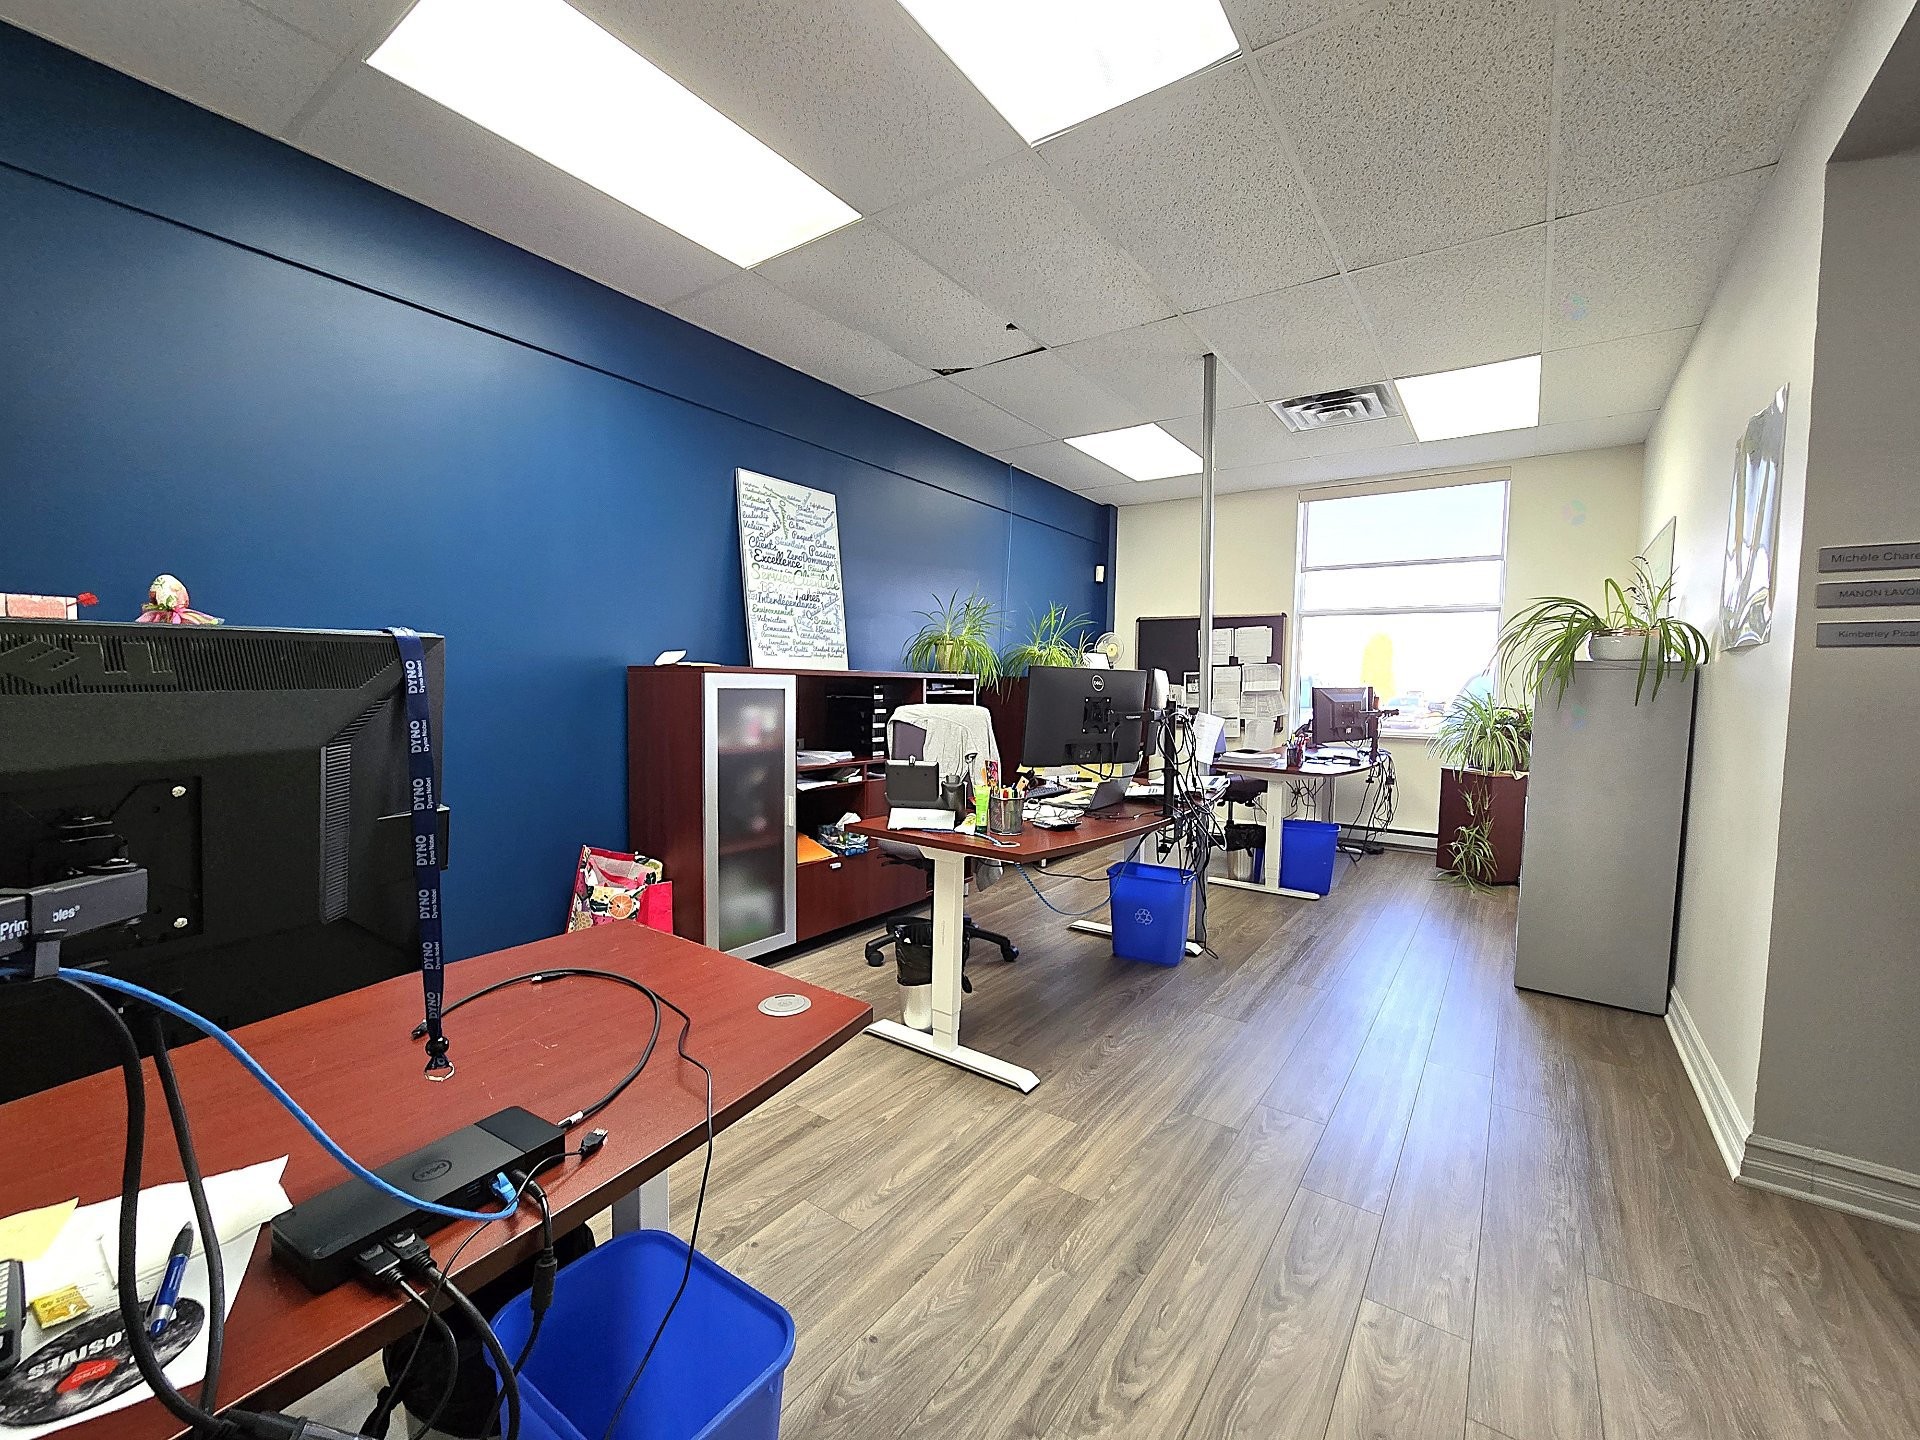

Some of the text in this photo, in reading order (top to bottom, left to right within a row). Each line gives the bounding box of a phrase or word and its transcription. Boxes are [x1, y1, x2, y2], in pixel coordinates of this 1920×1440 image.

[753, 548, 802, 568] Excellence
[1840, 589, 1881, 598] MANON
[405, 660, 419, 694] DYNO
[409, 720, 422, 754] DYNO
[412, 778, 425, 811] DYNO
[415, 835, 429, 866] DYNO
[418, 888, 431, 919] DYNO
[422, 941, 434, 970] DYNO
[426, 992, 438, 1019] DYNO
